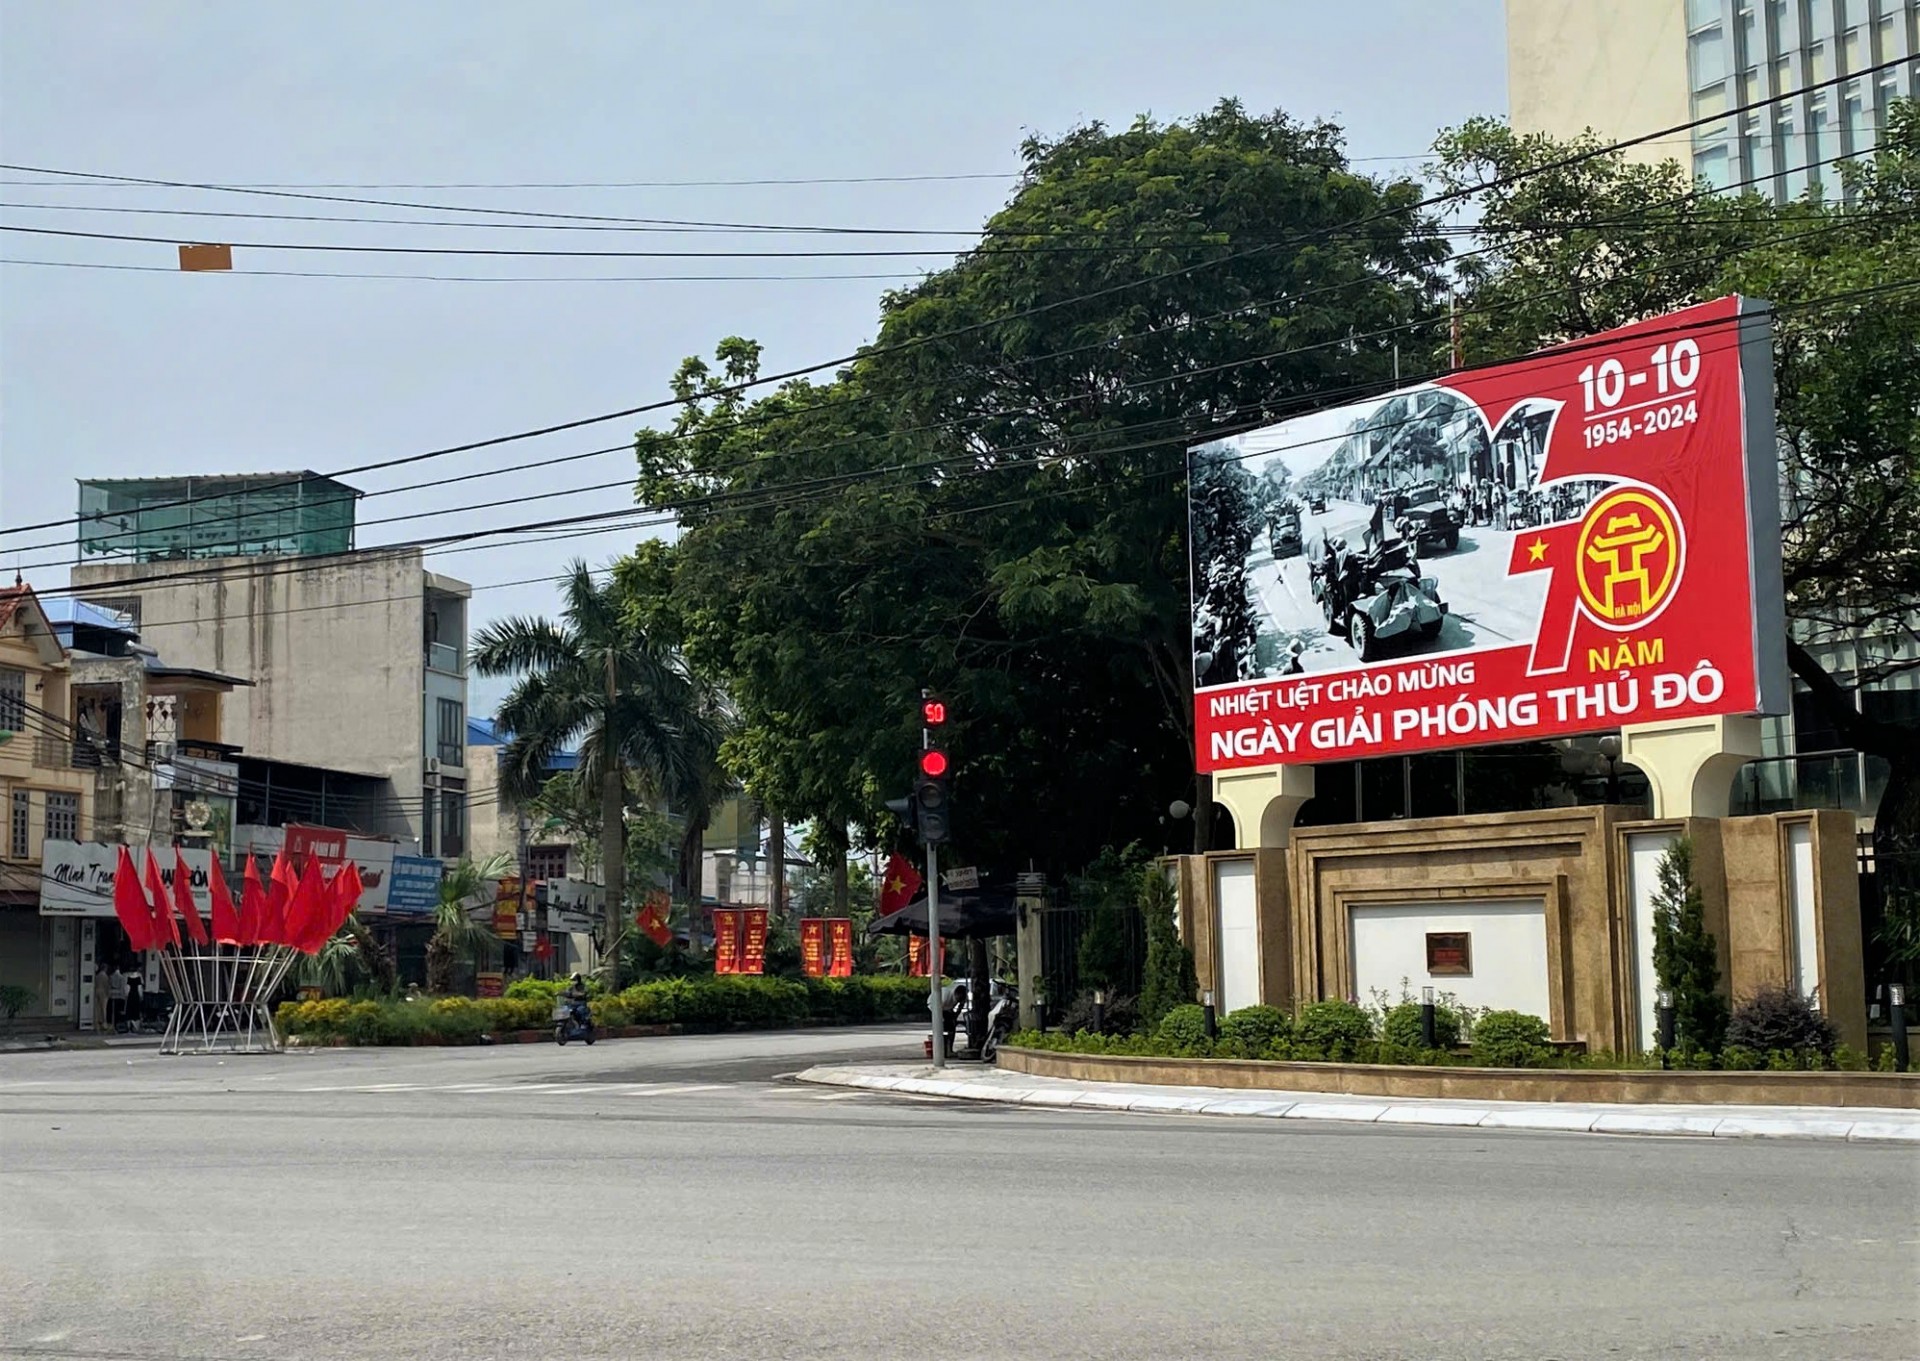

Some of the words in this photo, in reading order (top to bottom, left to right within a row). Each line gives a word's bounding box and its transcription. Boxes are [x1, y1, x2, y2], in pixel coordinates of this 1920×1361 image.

[1578, 338, 1700, 413] 10-10
[1583, 399, 1698, 449] 1954-2024
[1588, 636, 1664, 673] NĂM
[1210, 688, 1272, 717] NHIỆT
[1277, 681, 1323, 711] LIỆT
[1327, 673, 1392, 701] CHÀO
[1398, 661, 1475, 693] MỪNG
[1211, 719, 1304, 760] NGÀY
[1310, 706, 1383, 750] GIẢI
[1393, 692, 1539, 741] PHÓNG
[1546, 670, 1639, 722] THỦ
[1651, 659, 1724, 710] ĐÔ
[54, 863, 85, 883] Minh
